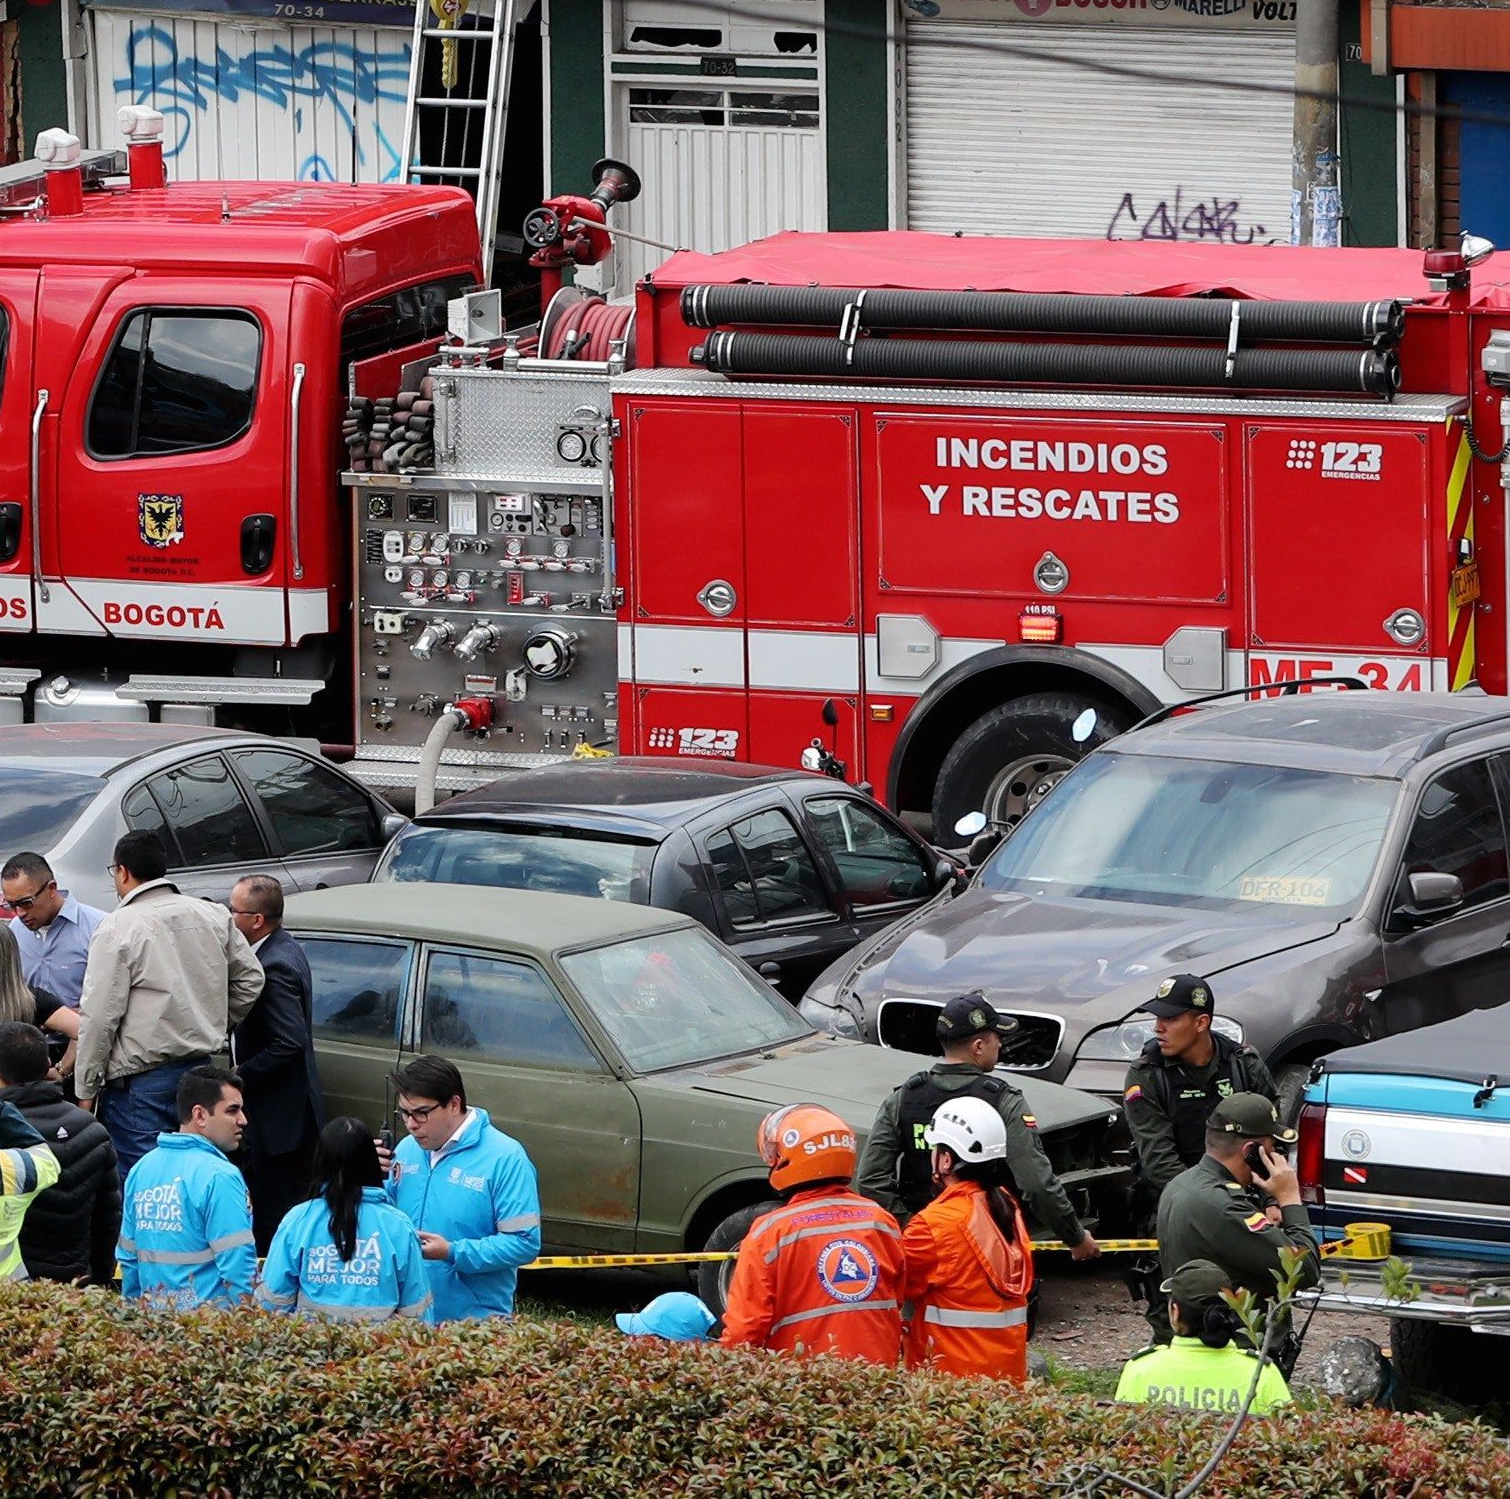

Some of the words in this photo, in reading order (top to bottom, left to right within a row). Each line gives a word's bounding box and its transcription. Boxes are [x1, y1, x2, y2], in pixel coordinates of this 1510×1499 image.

[274, 3, 325, 18] 70-34
[702, 61, 735, 75] 70-32
[936, 437, 1168, 476] INCENDIOS
[1320, 441, 1382, 473] 123
[1320, 470, 1381, 481] EMERGENCIAS
[919, 484, 949, 515] Y
[962, 486, 1181, 524] RESCATES
[103, 600, 225, 630] BOGOTÁ
[678, 727, 739, 750] 123
[678, 747, 736, 757] EMERGENCIAS
[307, 1257, 380, 1275] MEJOR
[340, 1273, 379, 1287] TODOS
[1147, 1385, 1242, 1411] POLICIA
